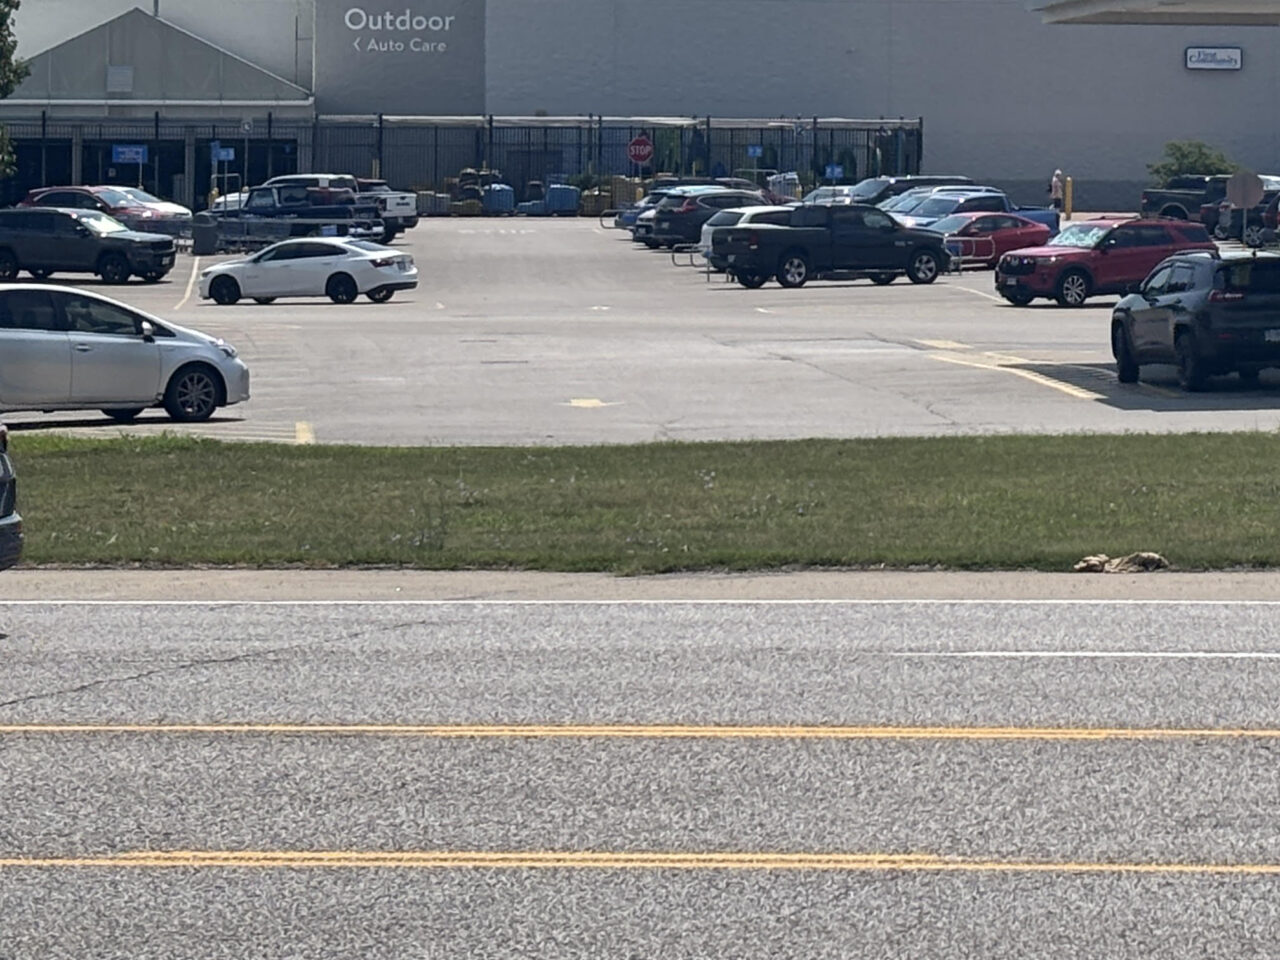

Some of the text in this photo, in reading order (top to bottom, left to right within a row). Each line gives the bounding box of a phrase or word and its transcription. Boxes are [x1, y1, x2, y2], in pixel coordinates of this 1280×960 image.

[344, 8, 455, 30] Outdoor
[367, 38, 447, 52] Auto Care
[630, 145, 652, 156] STOP
